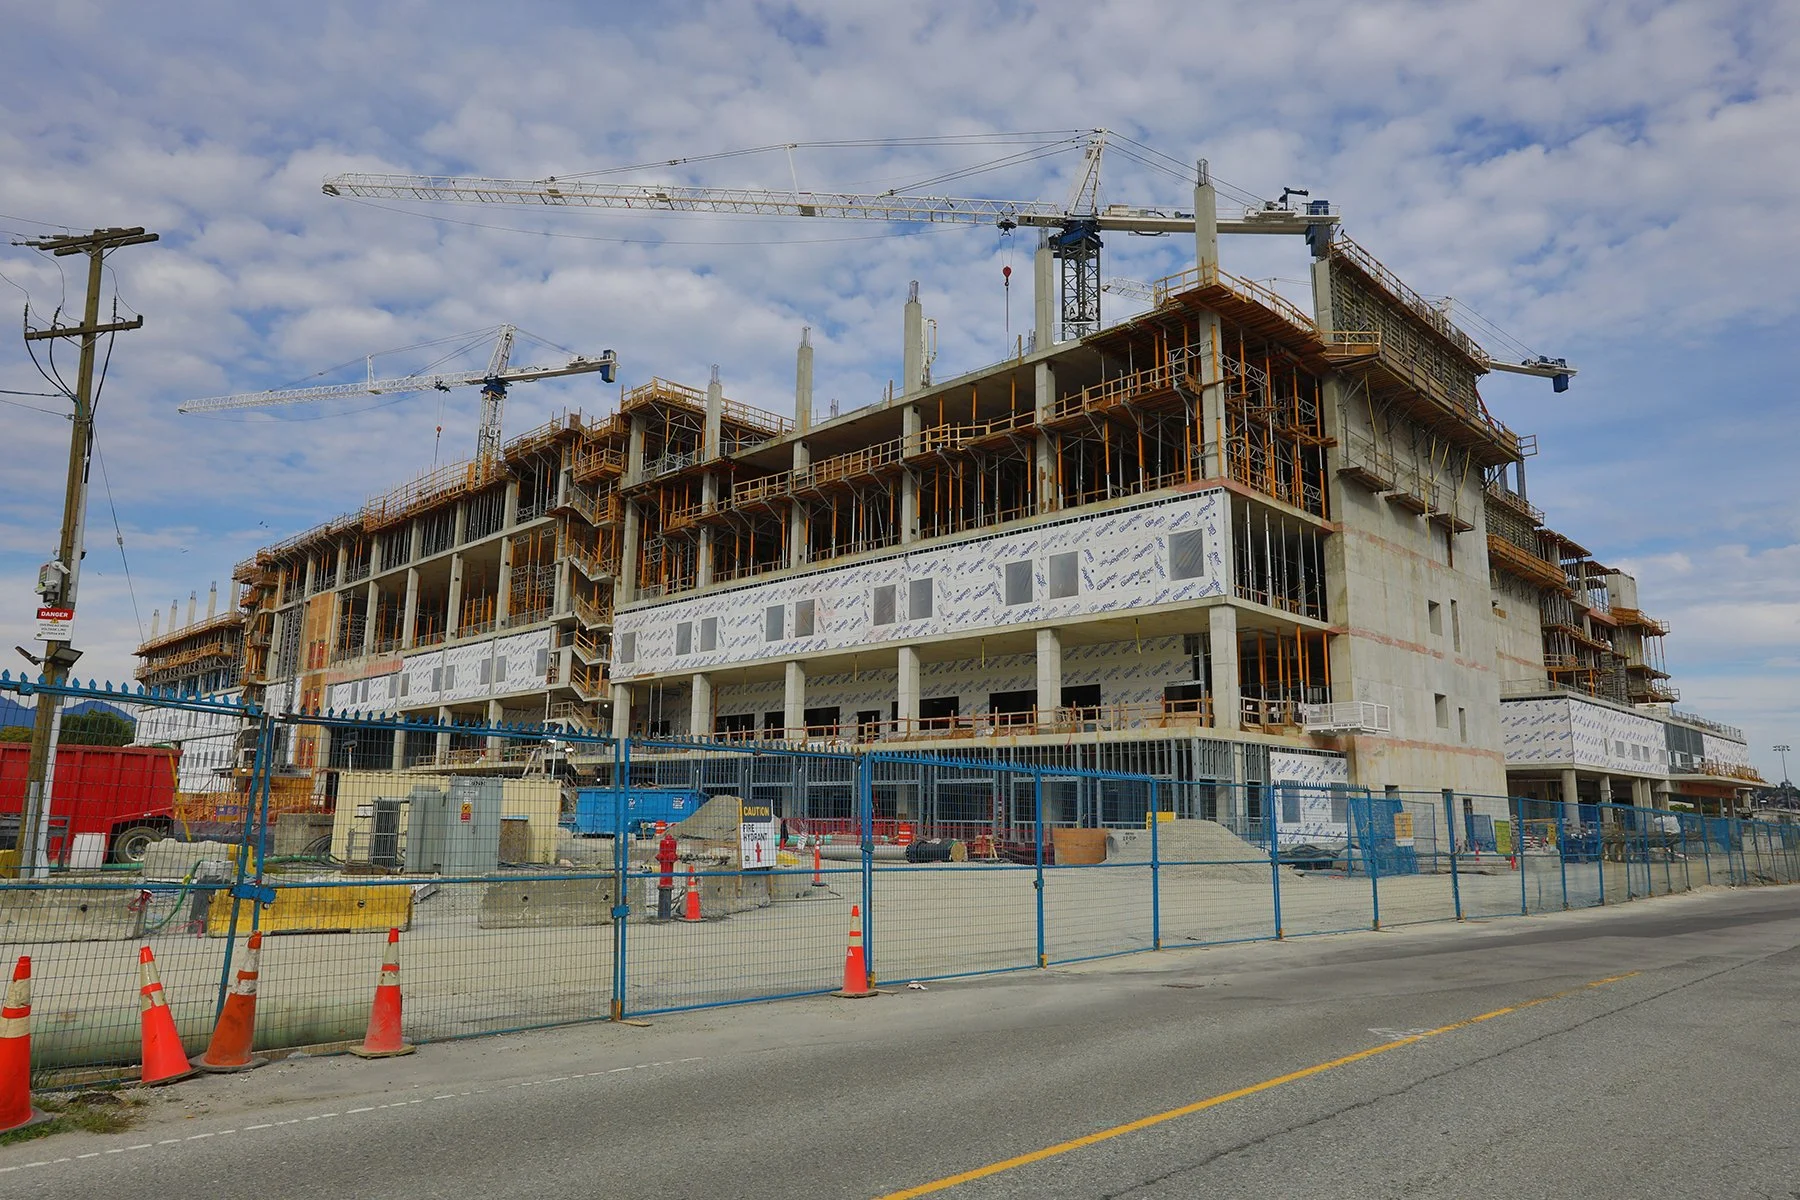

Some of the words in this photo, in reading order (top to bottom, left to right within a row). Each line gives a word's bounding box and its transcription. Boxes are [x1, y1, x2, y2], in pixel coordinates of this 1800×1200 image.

[1069, 306, 1076, 317] A
[1096, 519, 1116, 537] GlasRoc
[1097, 572, 1118, 591] GlasRoc
[1172, 582, 1196, 601] GlasRoc
[743, 806, 770, 817] CAUTION
[743, 824, 755, 833] FIRE
[743, 833, 768, 842] HYDRANT
